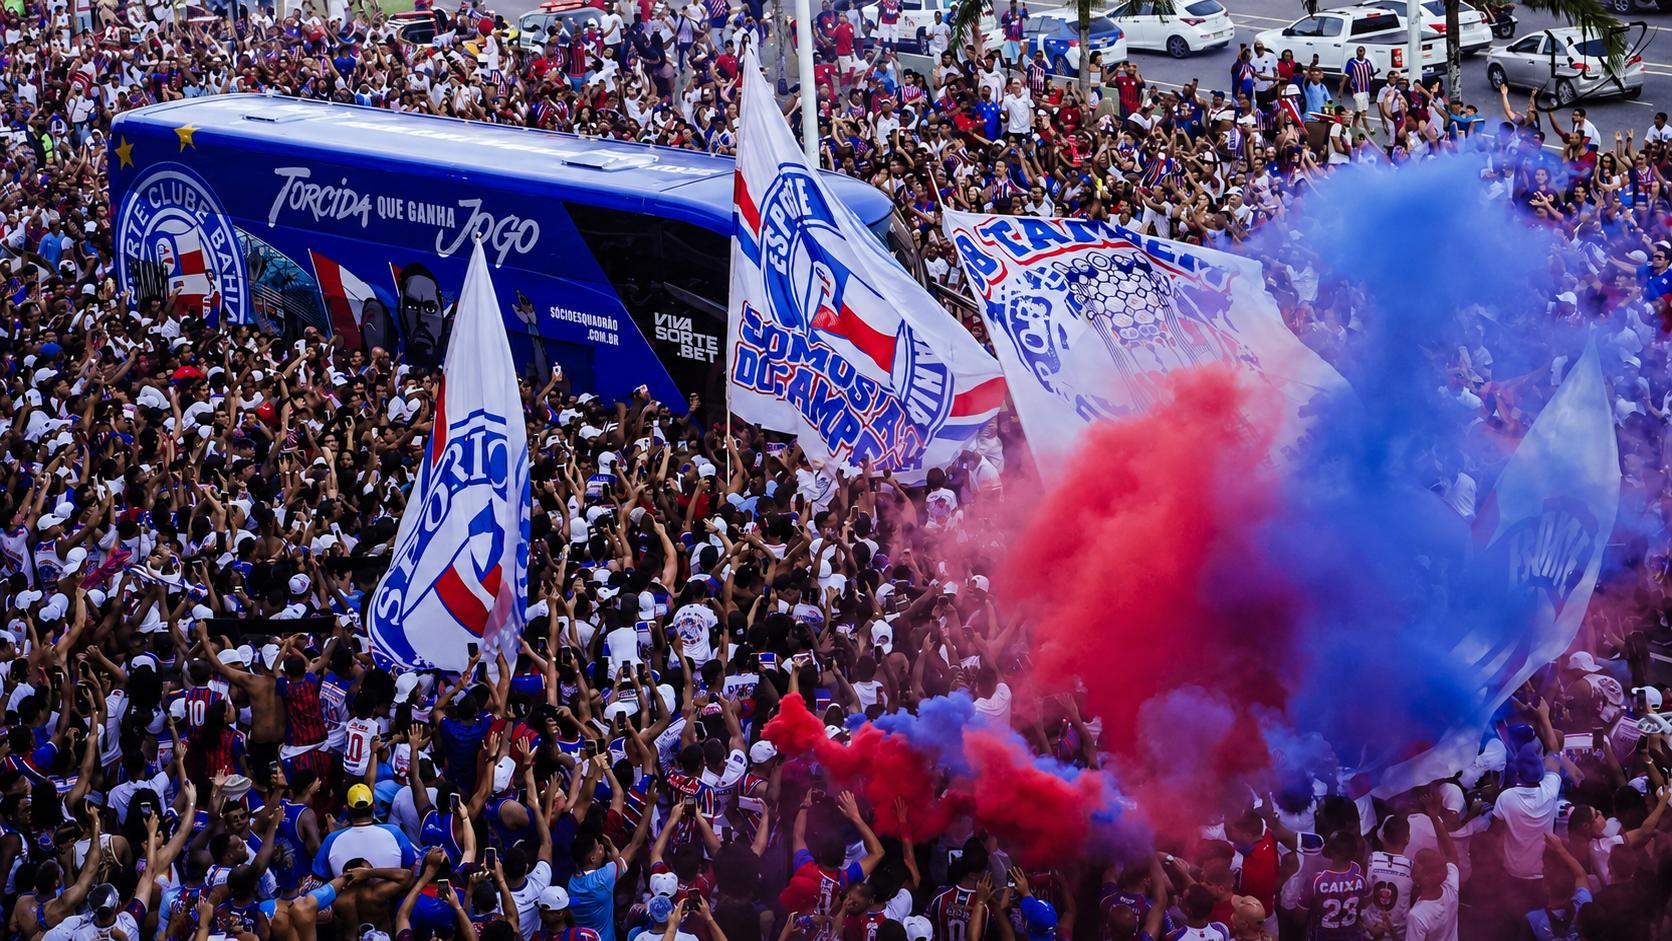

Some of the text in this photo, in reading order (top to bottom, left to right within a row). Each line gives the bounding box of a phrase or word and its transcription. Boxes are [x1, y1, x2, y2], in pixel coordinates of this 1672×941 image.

[149, 181, 210, 225] CLUBE
[377, 195, 404, 220] QUE
[407, 201, 456, 229] GANHA
[436, 198, 540, 269] JOGO
[550, 306, 618, 331] SÓCIOESQUADRÃO
[654, 311, 692, 332] VIVA
[587, 328, 619, 346] .COM.BR
[655, 326, 718, 351] SORTE
[677, 344, 719, 363] .BET
[188, 700, 206, 727] 10
[1319, 879, 1363, 894] CAIXA
